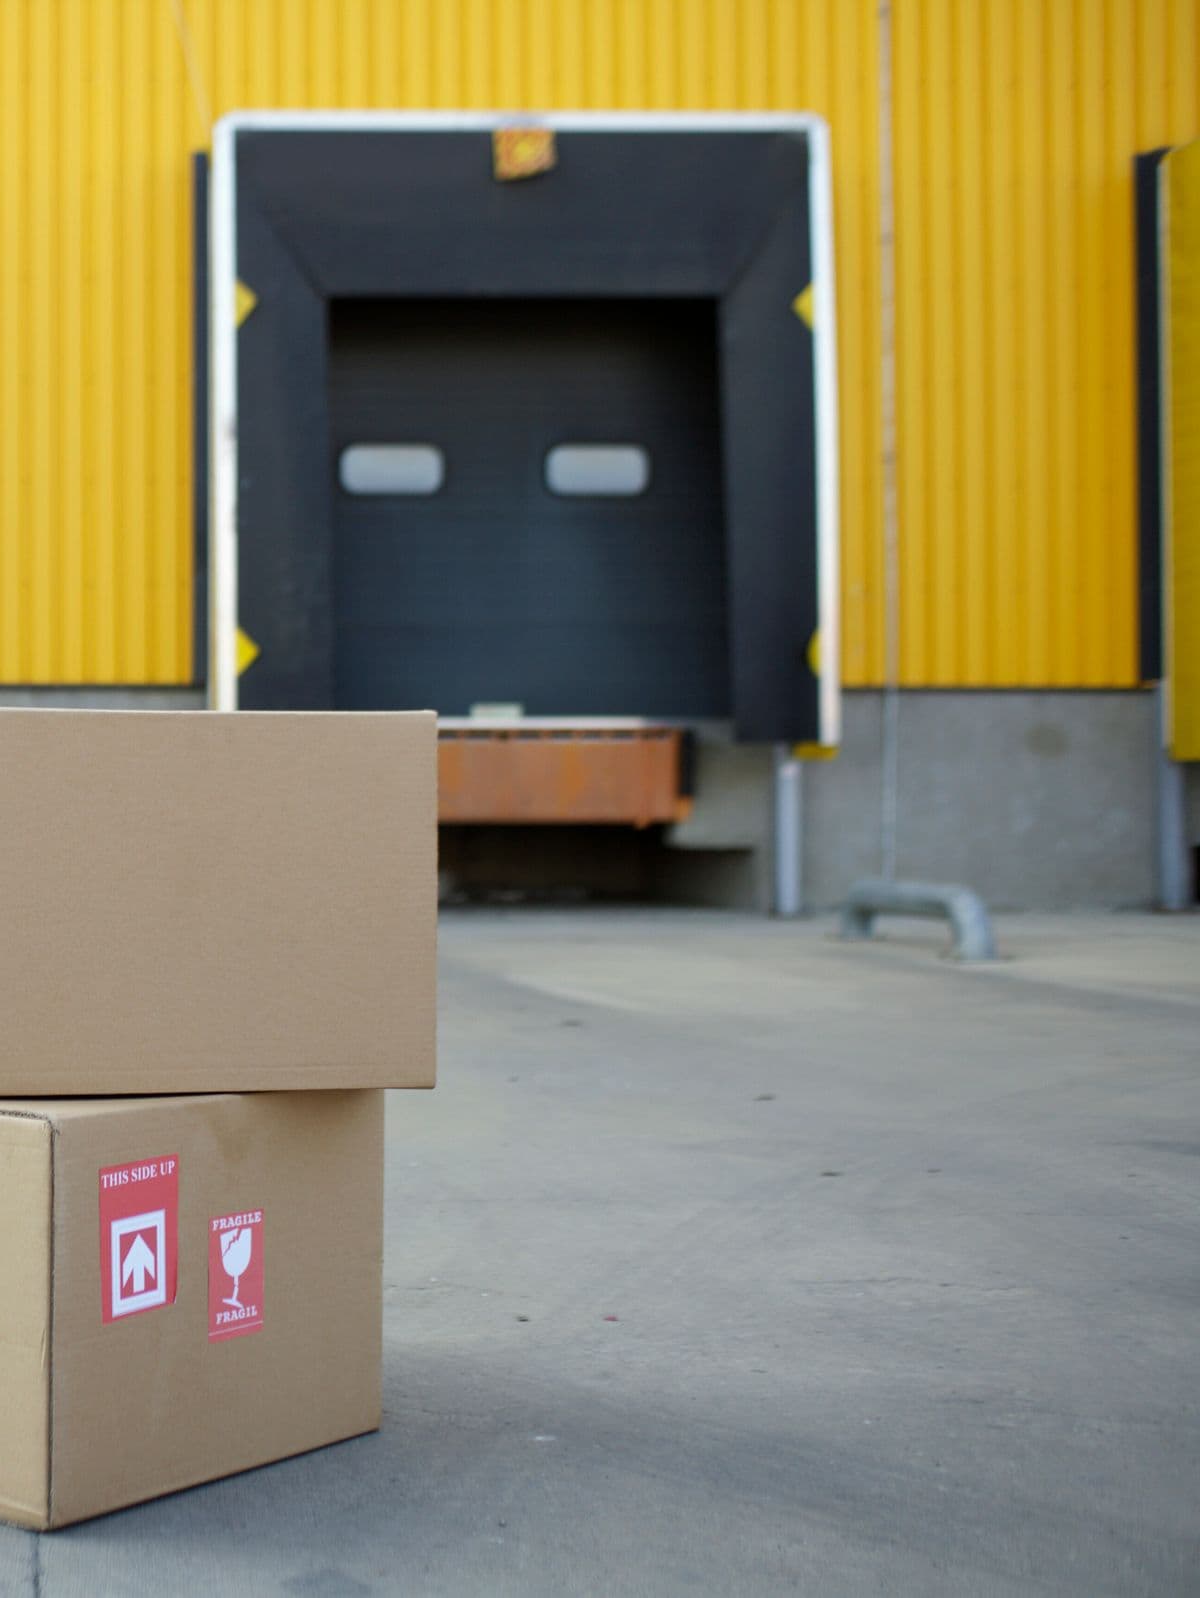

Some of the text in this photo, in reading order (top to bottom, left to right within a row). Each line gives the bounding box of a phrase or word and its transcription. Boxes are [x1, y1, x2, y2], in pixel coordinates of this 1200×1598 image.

[101, 1160, 175, 1189] THIS SIDE UP
[212, 1211, 261, 1231] FRAGILE
[215, 1304, 257, 1325] FRAGIL
